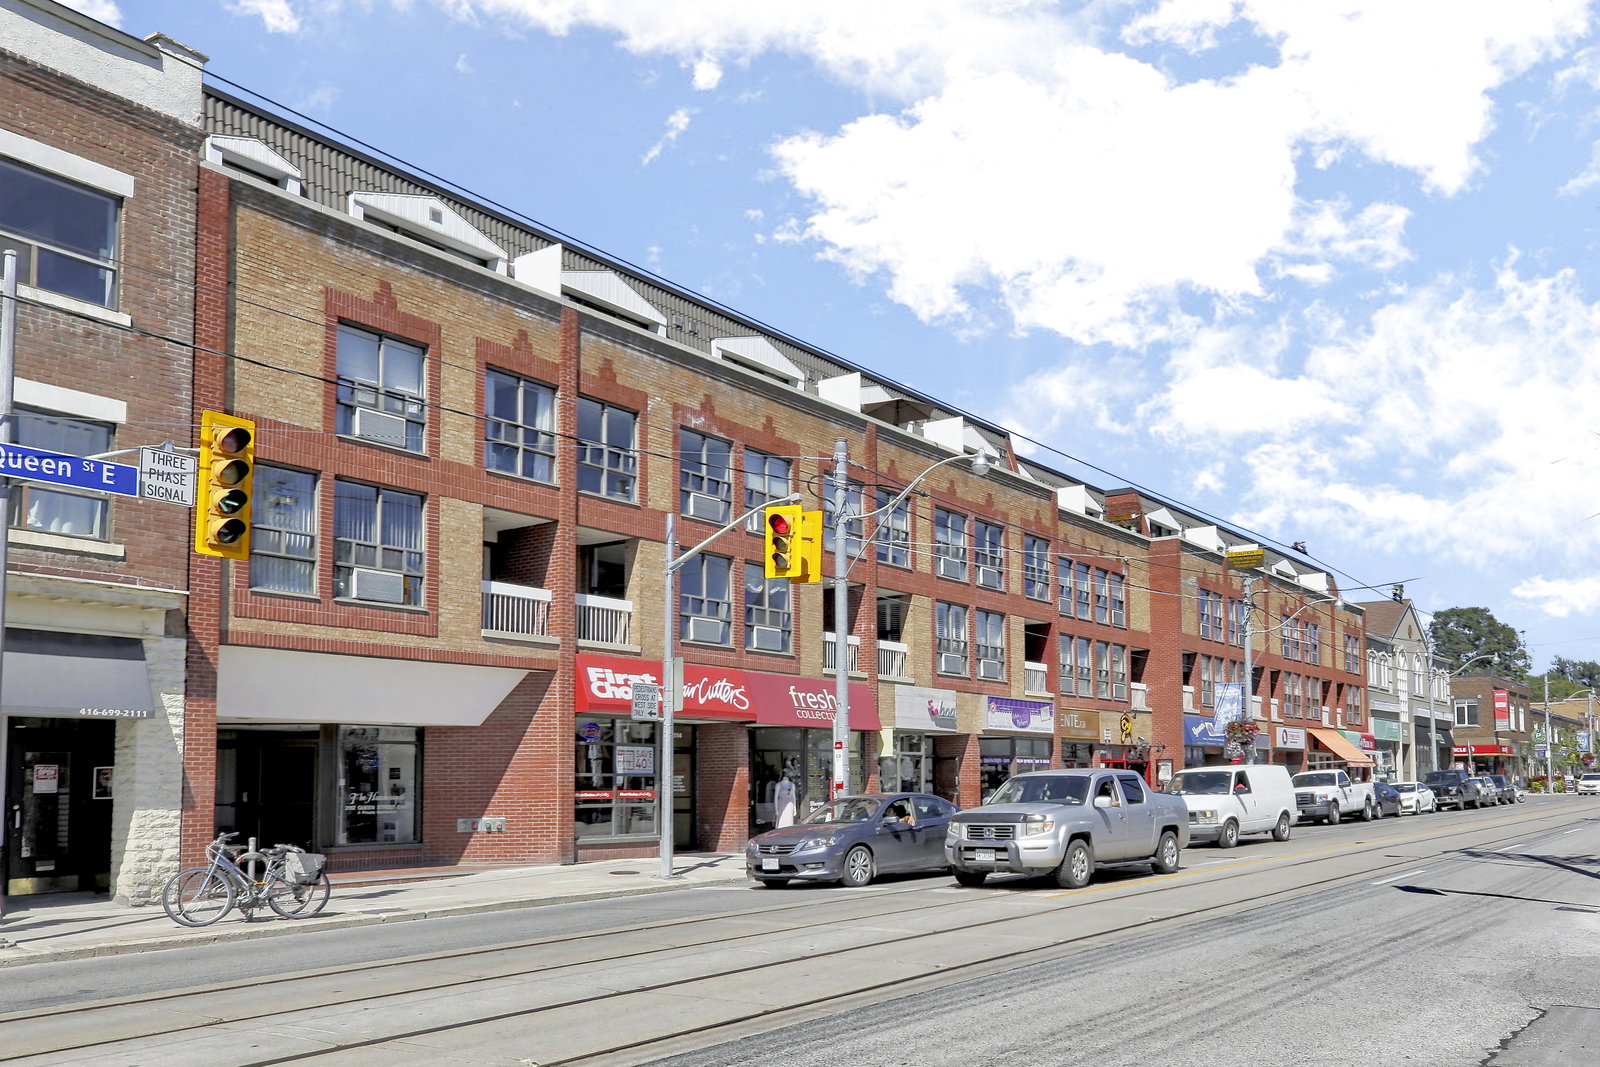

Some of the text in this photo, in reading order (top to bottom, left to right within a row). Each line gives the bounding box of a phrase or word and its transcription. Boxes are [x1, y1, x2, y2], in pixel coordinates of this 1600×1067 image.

[150, 451, 187, 470] THREE
[82, 460, 95, 473] St
[102, 463, 116, 485] E
[148, 467, 187, 487] PHASE
[146, 483, 188, 503] SIGNAL
[586, 666, 657, 686] First
[635, 693, 657, 702] CROSS AT
[635, 701, 657, 710] WEST SIDE
[788, 685, 837, 710] fresh
[79, 707, 148, 718] 416-699-2111
[633, 709, 645, 717] ONLY
[635, 750, 653, 759] SAVE
